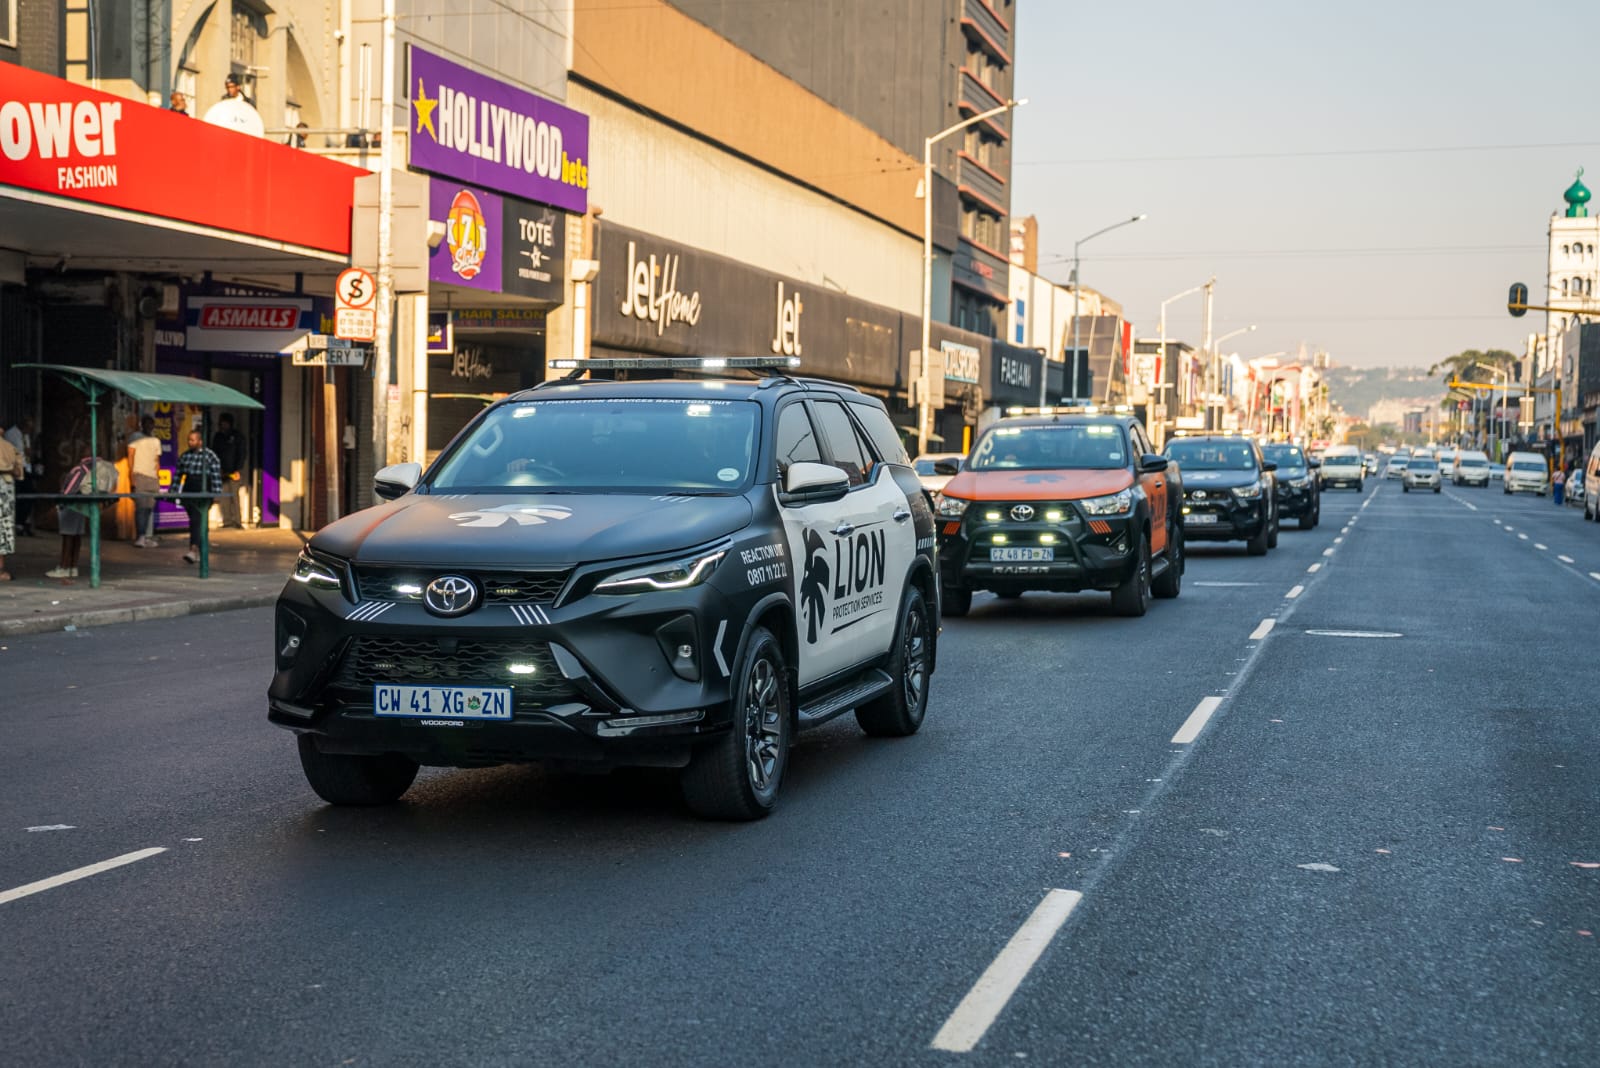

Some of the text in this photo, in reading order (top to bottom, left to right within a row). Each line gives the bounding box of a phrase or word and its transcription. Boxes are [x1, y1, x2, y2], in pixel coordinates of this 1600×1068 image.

[57, 165, 118, 190] FASHION
[518, 218, 552, 247] TOTE
[348, 278, 363, 299] S
[621, 241, 661, 322] Jet
[207, 308, 292, 327] ASMALLS
[461, 310, 545, 320] HAIR SALON
[772, 281, 802, 356] Jet
[740, 545, 775, 565] REACTION
[834, 528, 885, 601] LION
[747, 566, 766, 586] 0817
[833, 591, 883, 620] PROTECTION SERVICES
[379, 688, 505, 715] CW 41 XG ZN
[420, 719, 464, 727] WOODFORD
